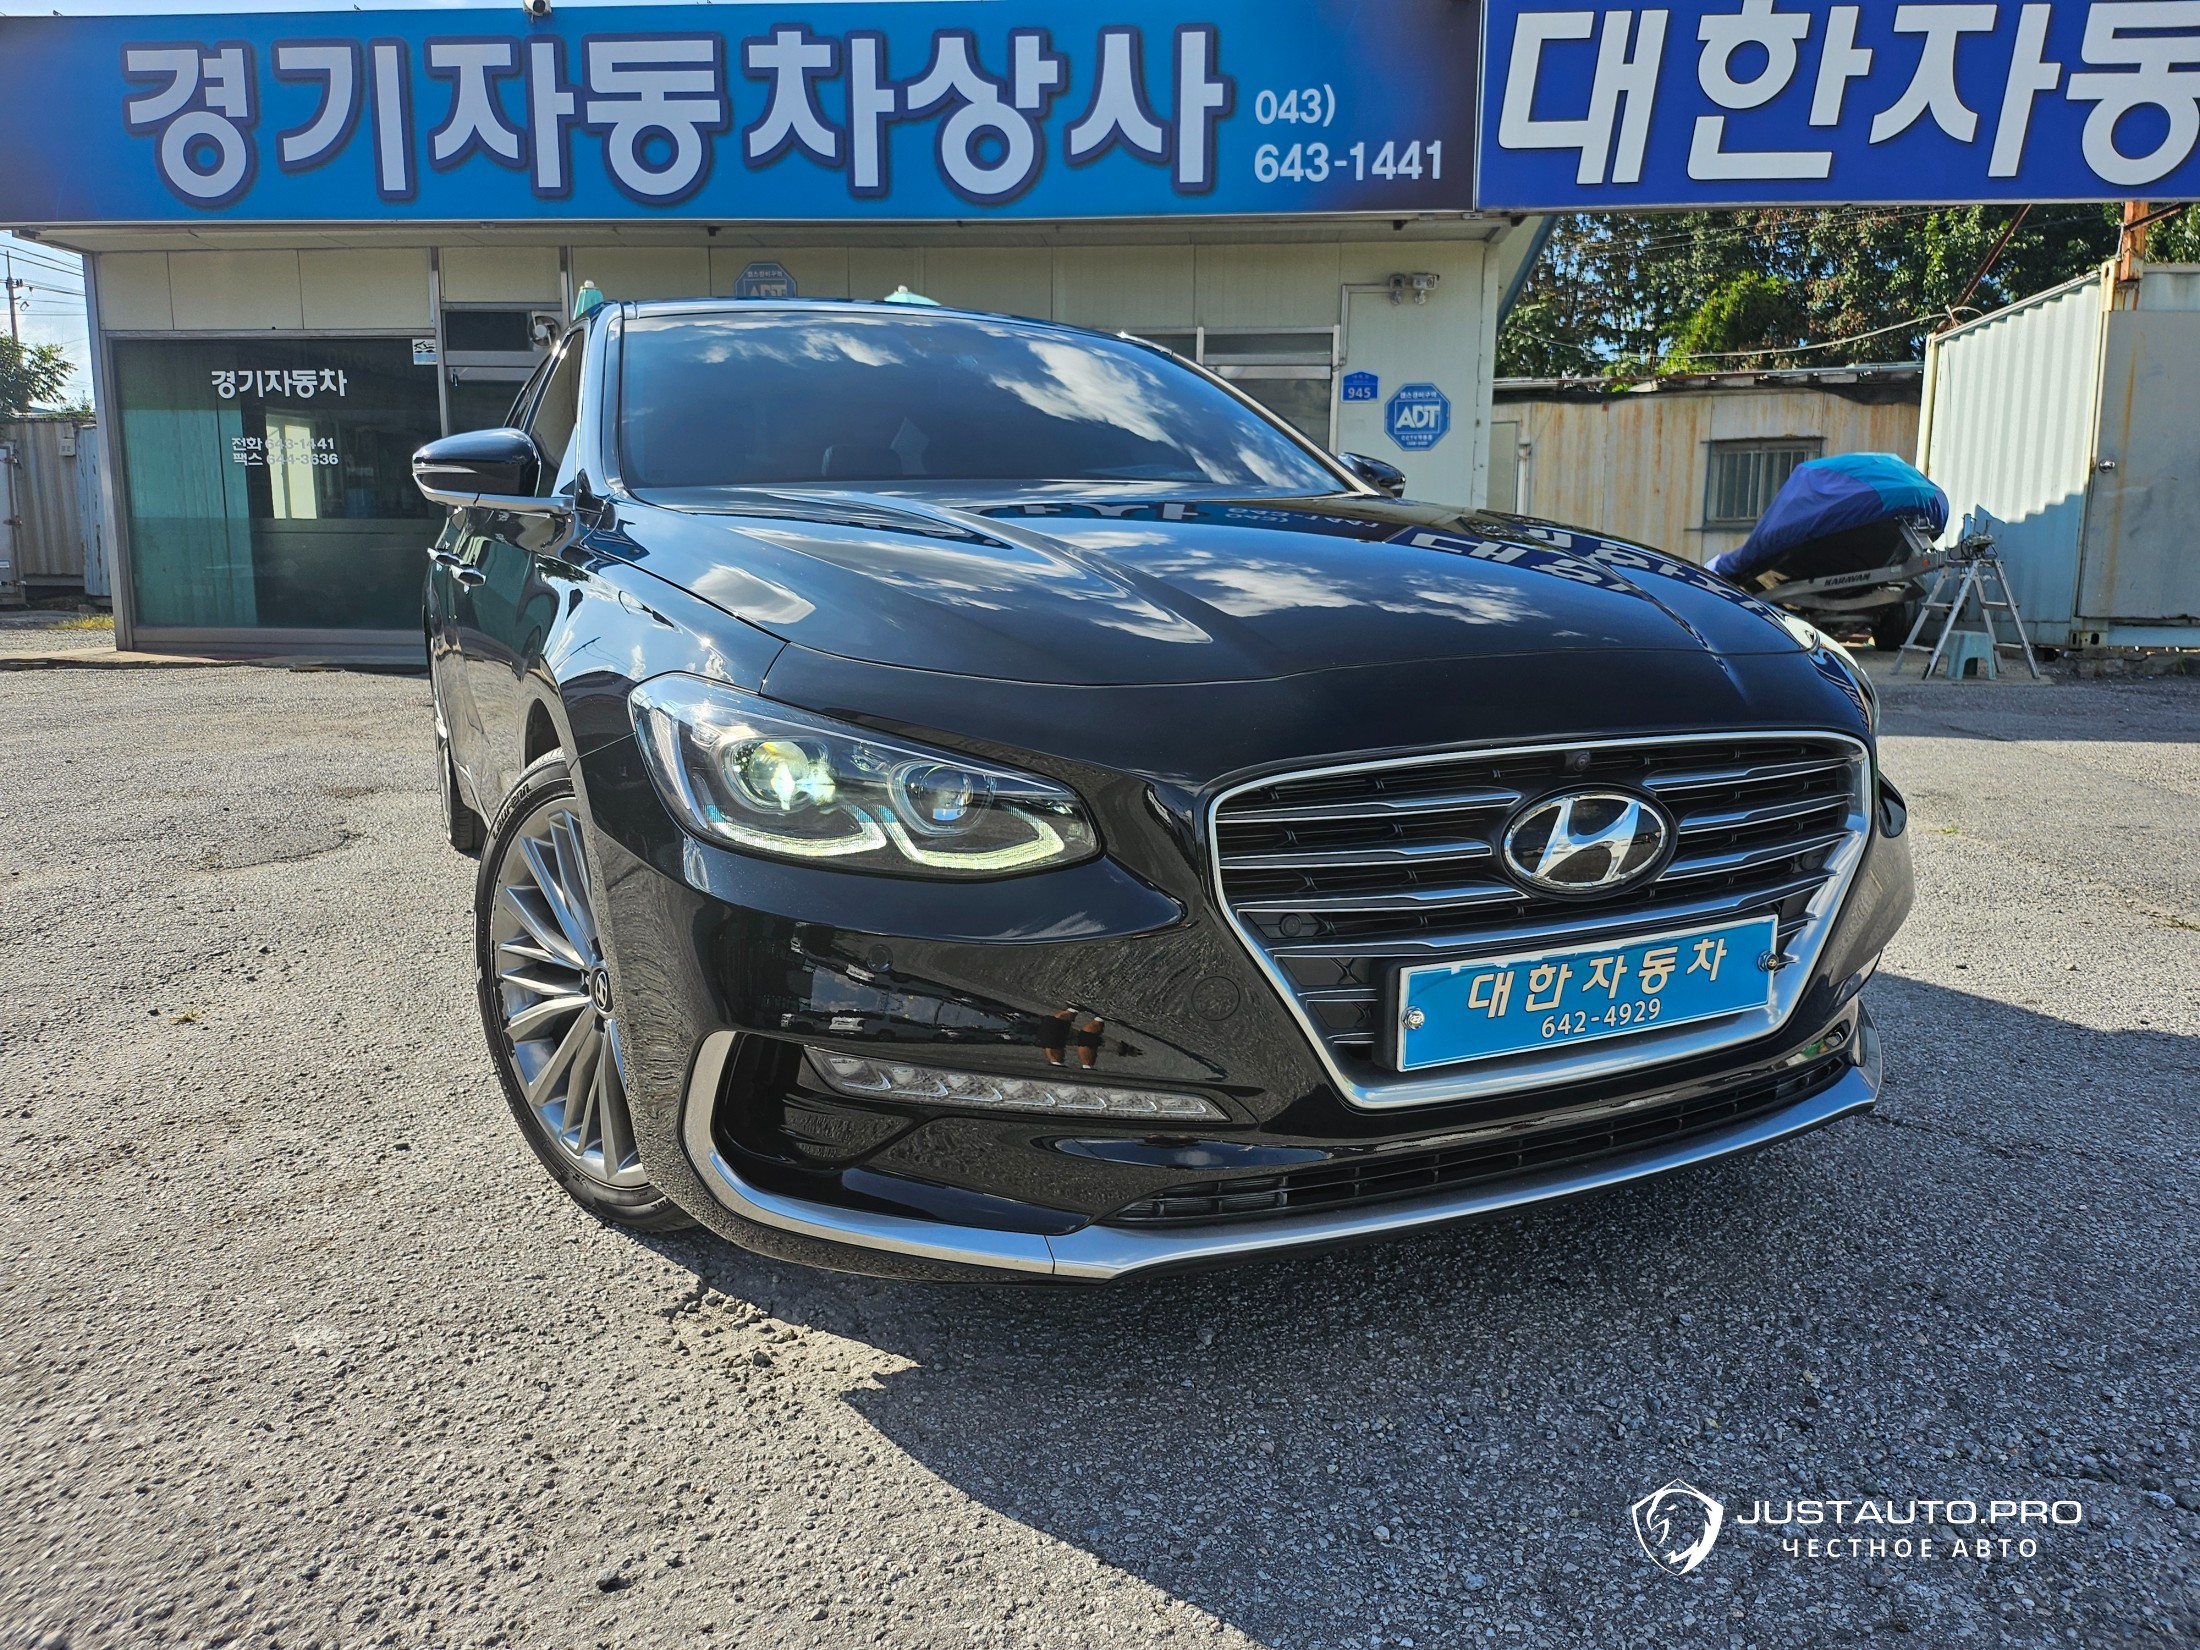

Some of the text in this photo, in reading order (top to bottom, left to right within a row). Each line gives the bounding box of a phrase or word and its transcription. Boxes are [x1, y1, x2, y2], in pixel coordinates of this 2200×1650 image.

[122, 27, 1228, 202] 경기자동차상사
[1254, 84, 1336, 127] 043)
[1253, 140, 1443, 185] 643-1441
[211, 368, 348, 399] 경기자동차
[1347, 387, 1372, 399] 945
[1395, 404, 1441, 429] ADT
[231, 437, 335, 451] 전화 643-1441
[233, 453, 339, 466] 팩스 644-3636
[1824, 573, 1871, 587] KARAVAN
[1541, 997, 1663, 1039] 642-4929
